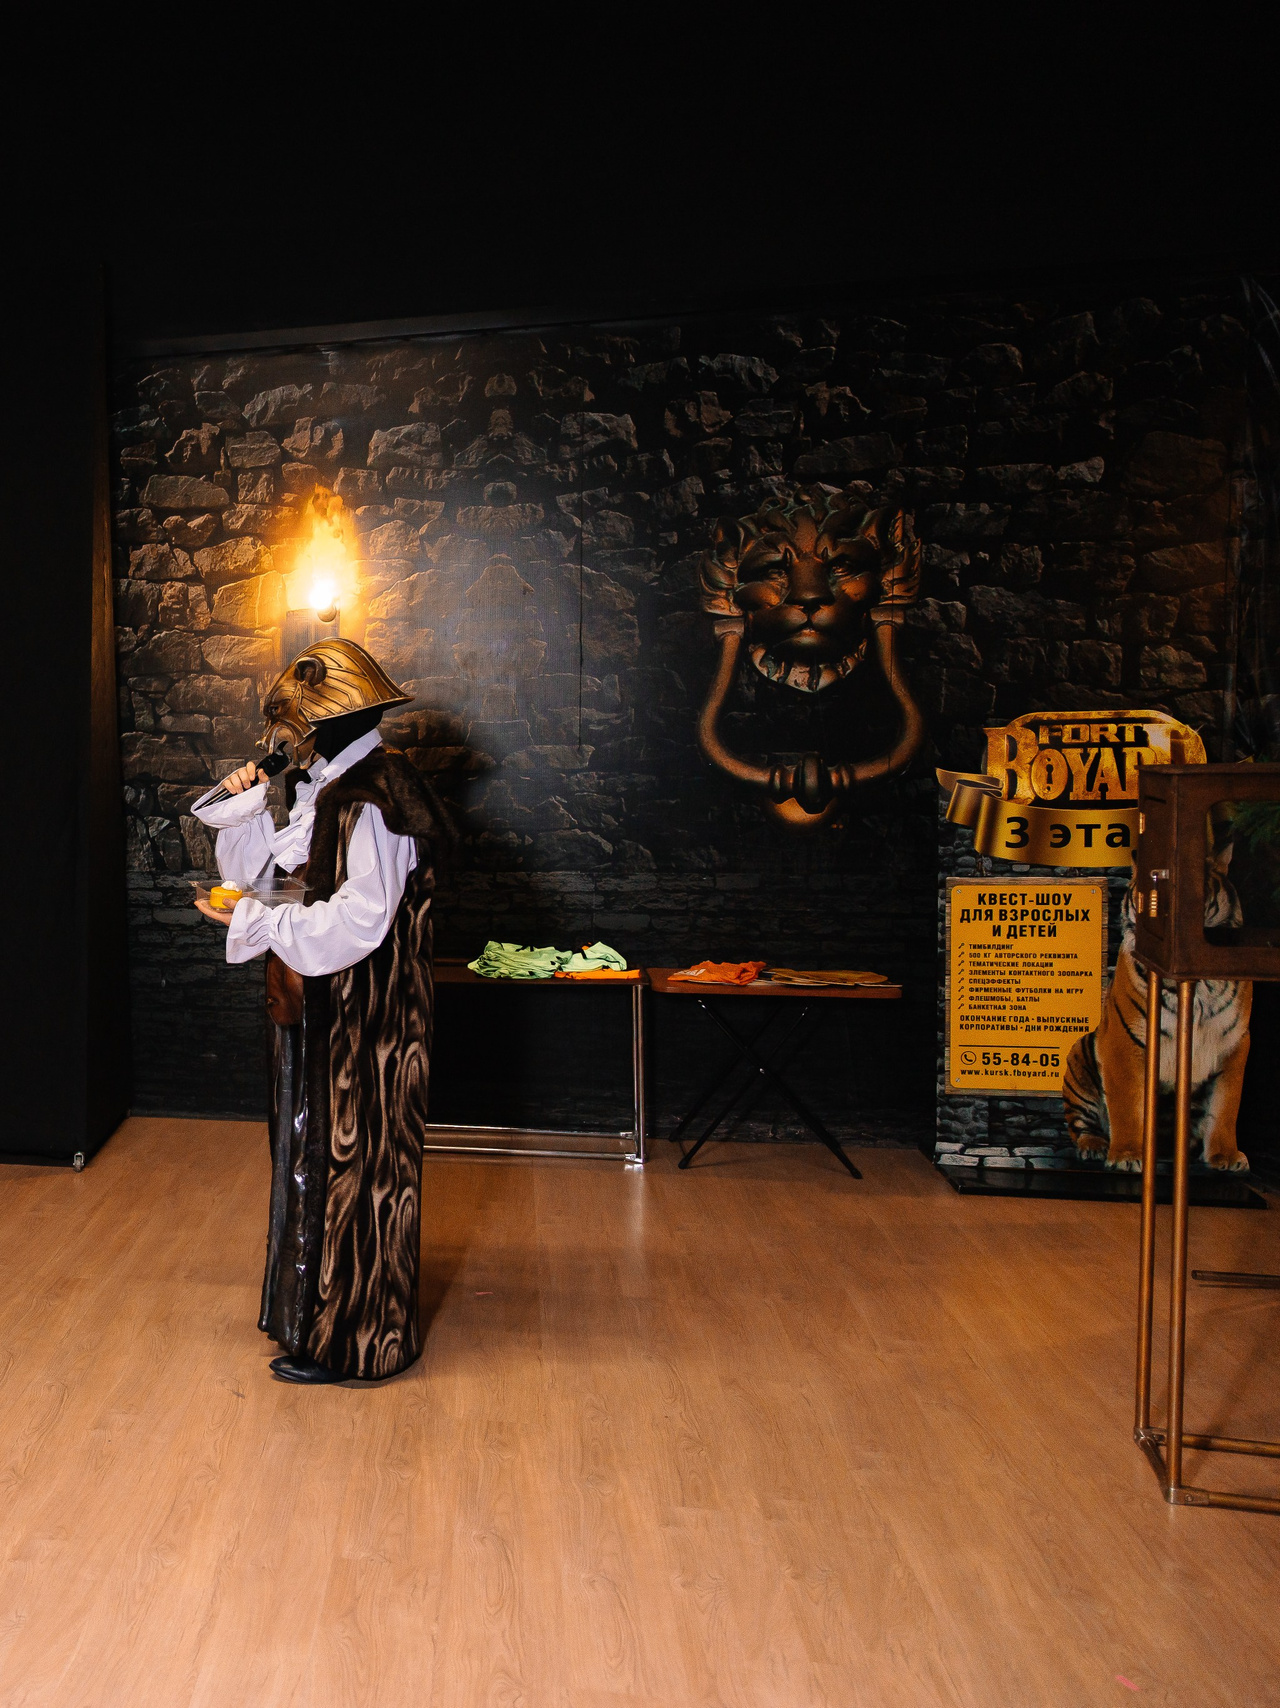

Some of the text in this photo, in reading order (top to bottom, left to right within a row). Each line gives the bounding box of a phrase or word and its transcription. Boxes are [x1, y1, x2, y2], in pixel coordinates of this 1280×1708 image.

[1038, 723, 1145, 745] FORT
[1005, 816, 1132, 849] 3 эта
[977, 892, 1073, 906] КВЕСТ-ШОУ
[959, 908, 1091, 923] ДЛЯ ВЗРОСЛЫХ
[992, 922, 1057, 939] И ДЕТЕЙ
[968, 943, 1014, 951] ТИМБИЛДИНГ
[1021, 961, 1054, 969] ЛОКАЦИИ
[959, 1014, 1090, 1024] ОКОНЧАНИЕ ГОДА ВЫПУСКНЫЕ
[959, 1023, 1090, 1033] КОРПОРАТИВЫ ДНИ РОЖДЕНИЯ
[981, 1052, 1060, 1067] 55-84-05
[960, 1068, 1060, 1078] www.kursk.fboyard.ru
